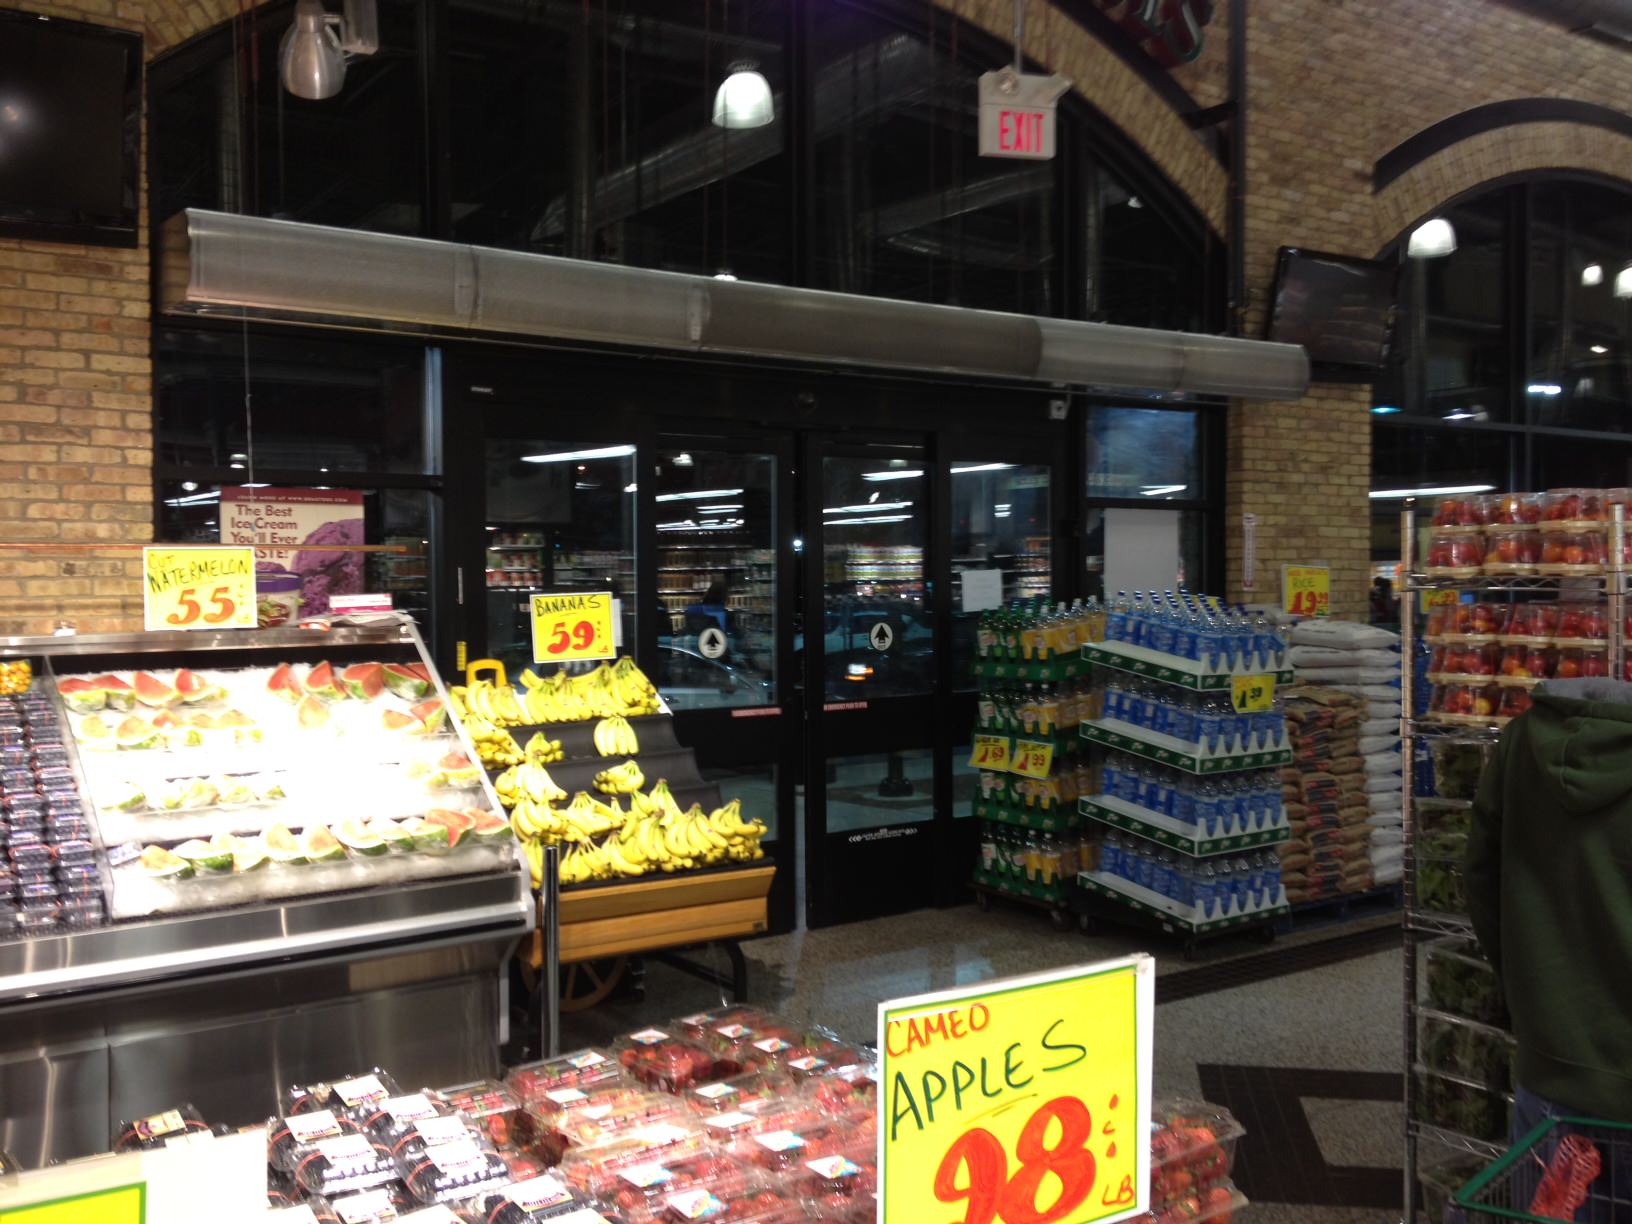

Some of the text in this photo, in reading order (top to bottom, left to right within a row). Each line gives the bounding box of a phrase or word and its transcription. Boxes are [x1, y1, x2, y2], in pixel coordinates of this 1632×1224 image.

[999, 111, 1043, 152] EXIT
[230, 517, 298, 530] Ice Cream
[235, 504, 293, 517] The Best
[230, 532, 298, 544] You'll Ever
[147, 559, 248, 593] WATERMELON
[148, 553, 175, 569] CUT
[166, 586, 235, 625] 55
[534, 594, 602, 617] BANANAS
[546, 620, 595, 654] 59
[886, 1003, 990, 1058] CAMEO
[891, 1019, 1087, 1141] APPLES
[934, 1096, 1097, 1223] 98
[1102, 1174, 1135, 1206] LB
